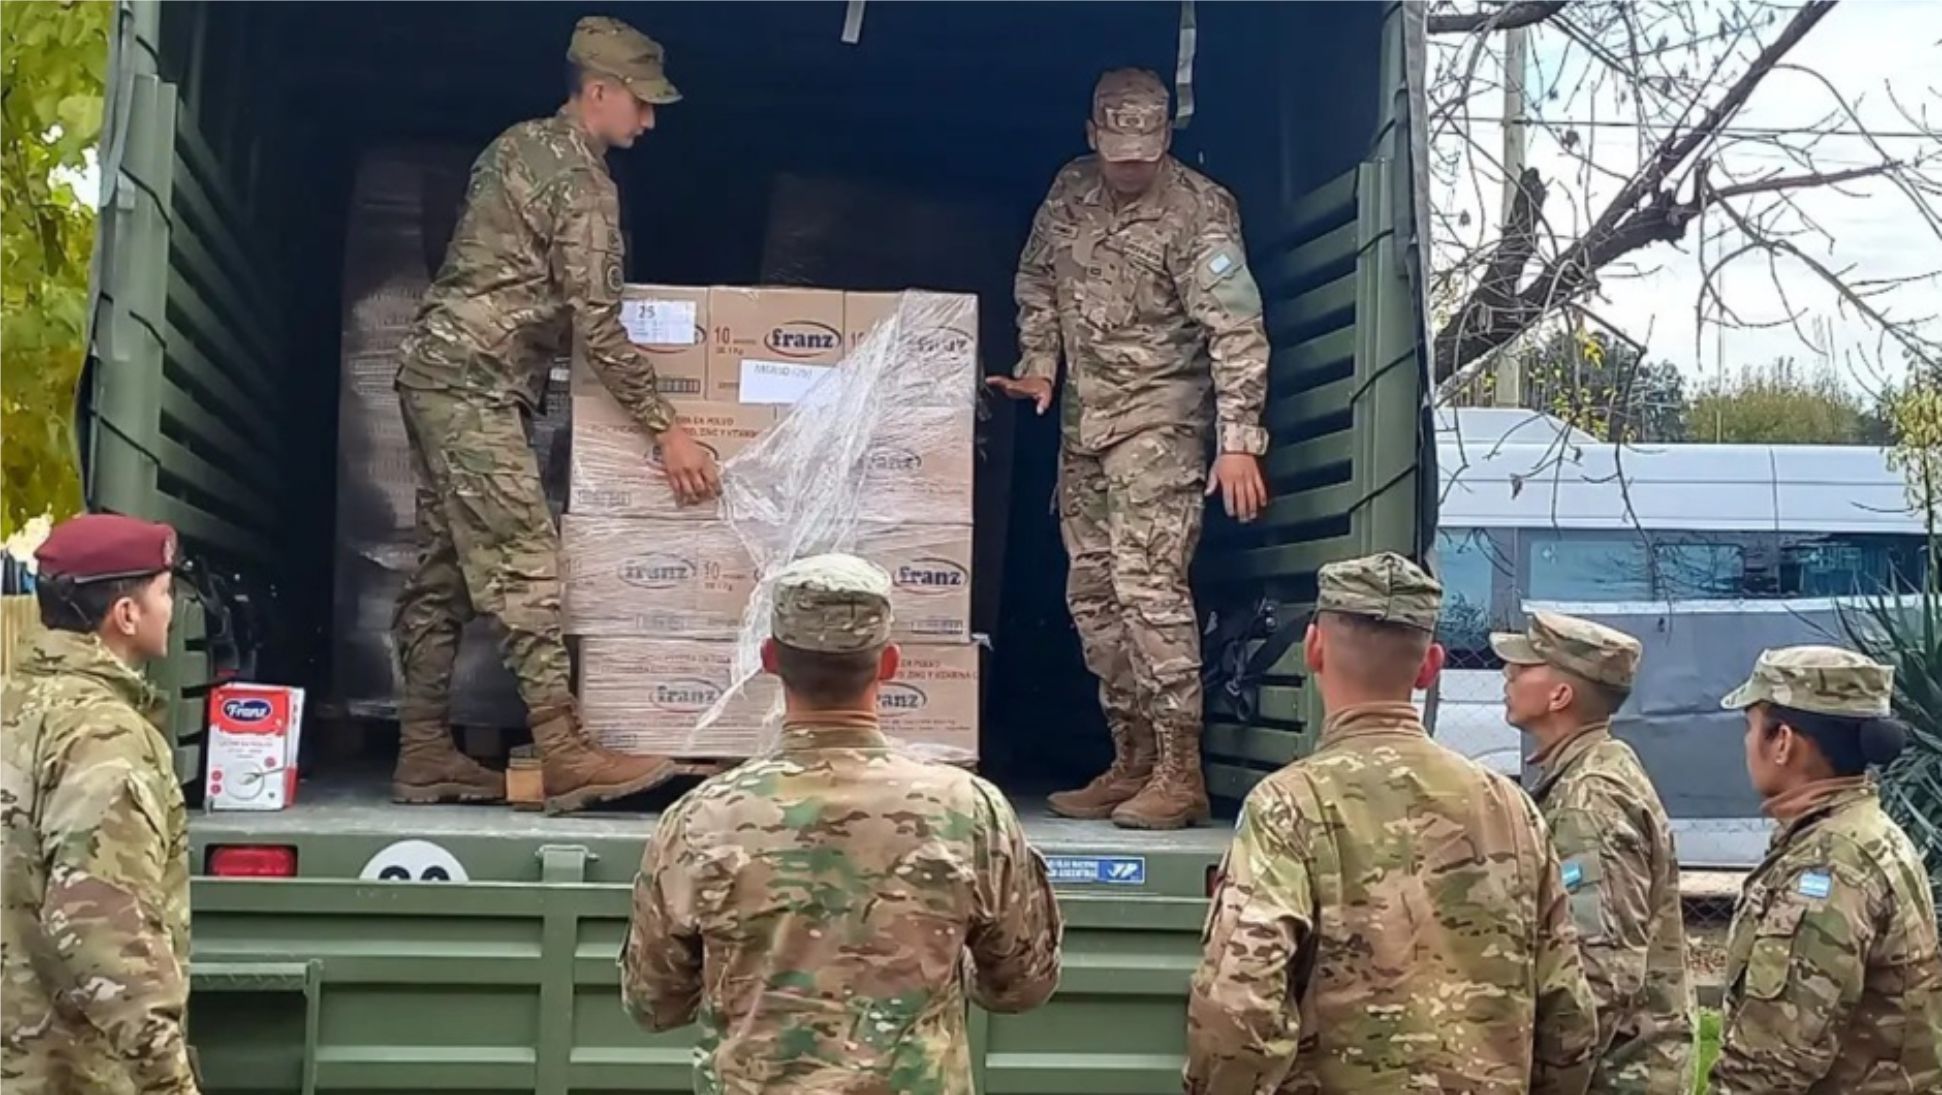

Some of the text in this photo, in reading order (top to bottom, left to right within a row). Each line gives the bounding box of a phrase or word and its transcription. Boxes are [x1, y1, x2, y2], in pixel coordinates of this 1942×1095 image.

[714, 326, 730, 344] 10
[772, 328, 834, 349] franz
[899, 565, 961, 586] franz
[656, 685, 716, 705] franz
[877, 693, 919, 708] anz
[226, 703, 269, 718] Franz
